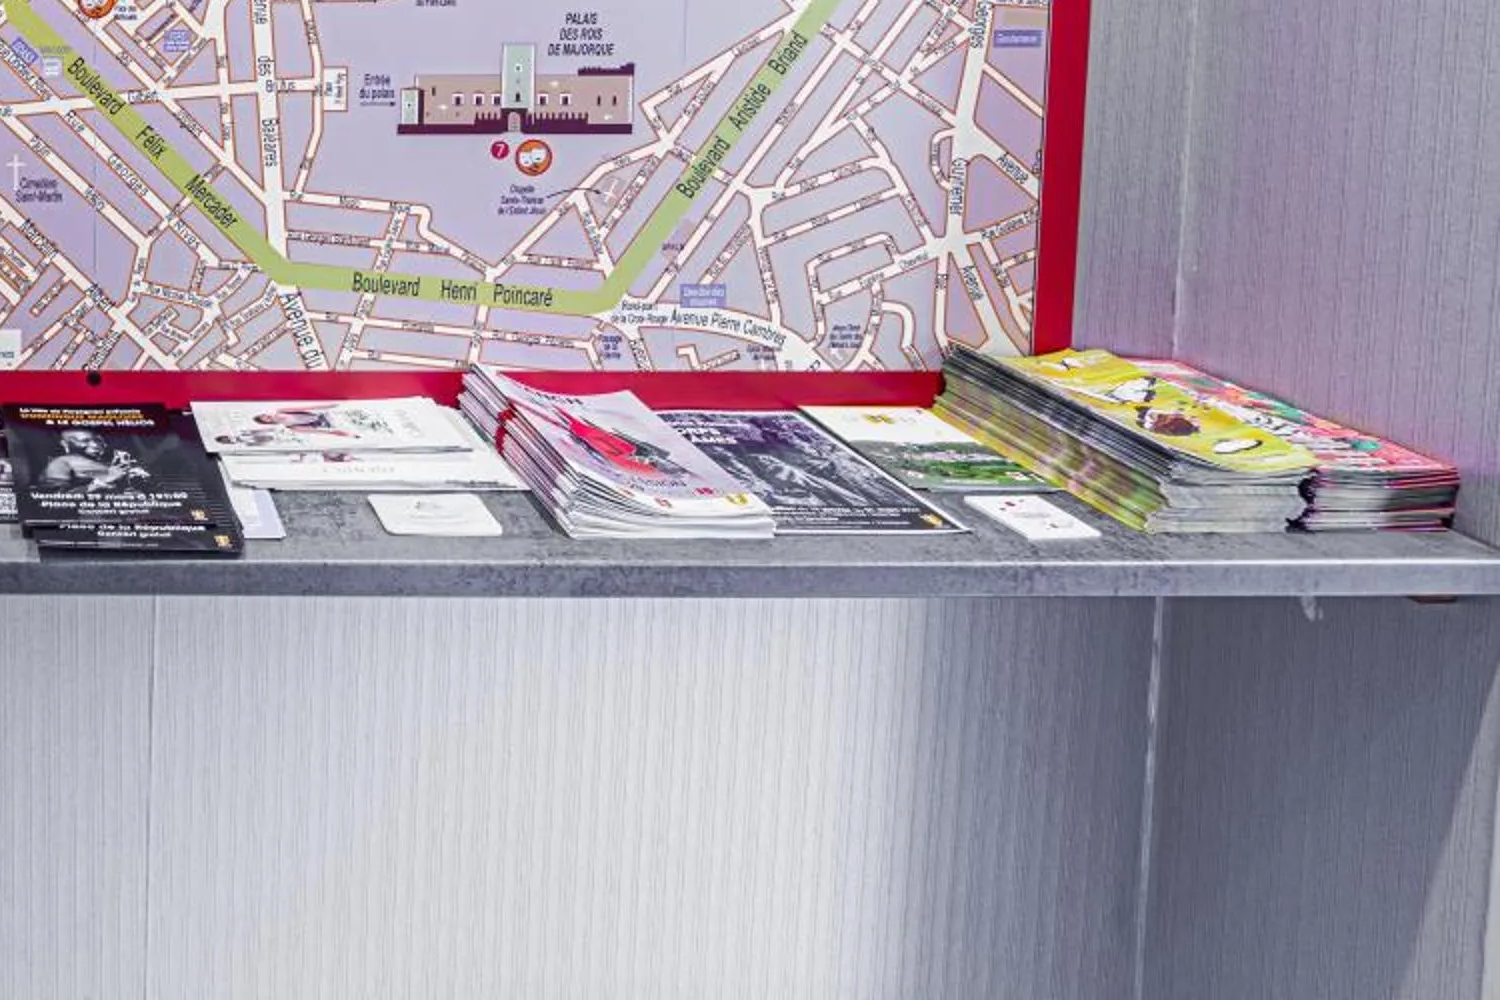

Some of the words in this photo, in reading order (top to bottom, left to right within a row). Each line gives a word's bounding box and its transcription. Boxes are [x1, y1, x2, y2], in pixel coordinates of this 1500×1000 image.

[565, 13, 598, 26] PALAIS
[67, 57, 124, 116] Boulevard
[135, 125, 166, 160] Félix
[676, 136, 733, 200] Boulevard
[728, 83, 772, 134] Aristide
[768, 30, 808, 75] Briand
[352, 272, 422, 298] Boulevard
[440, 279, 479, 301] Henri
[492, 282, 554, 307] Poincaré
